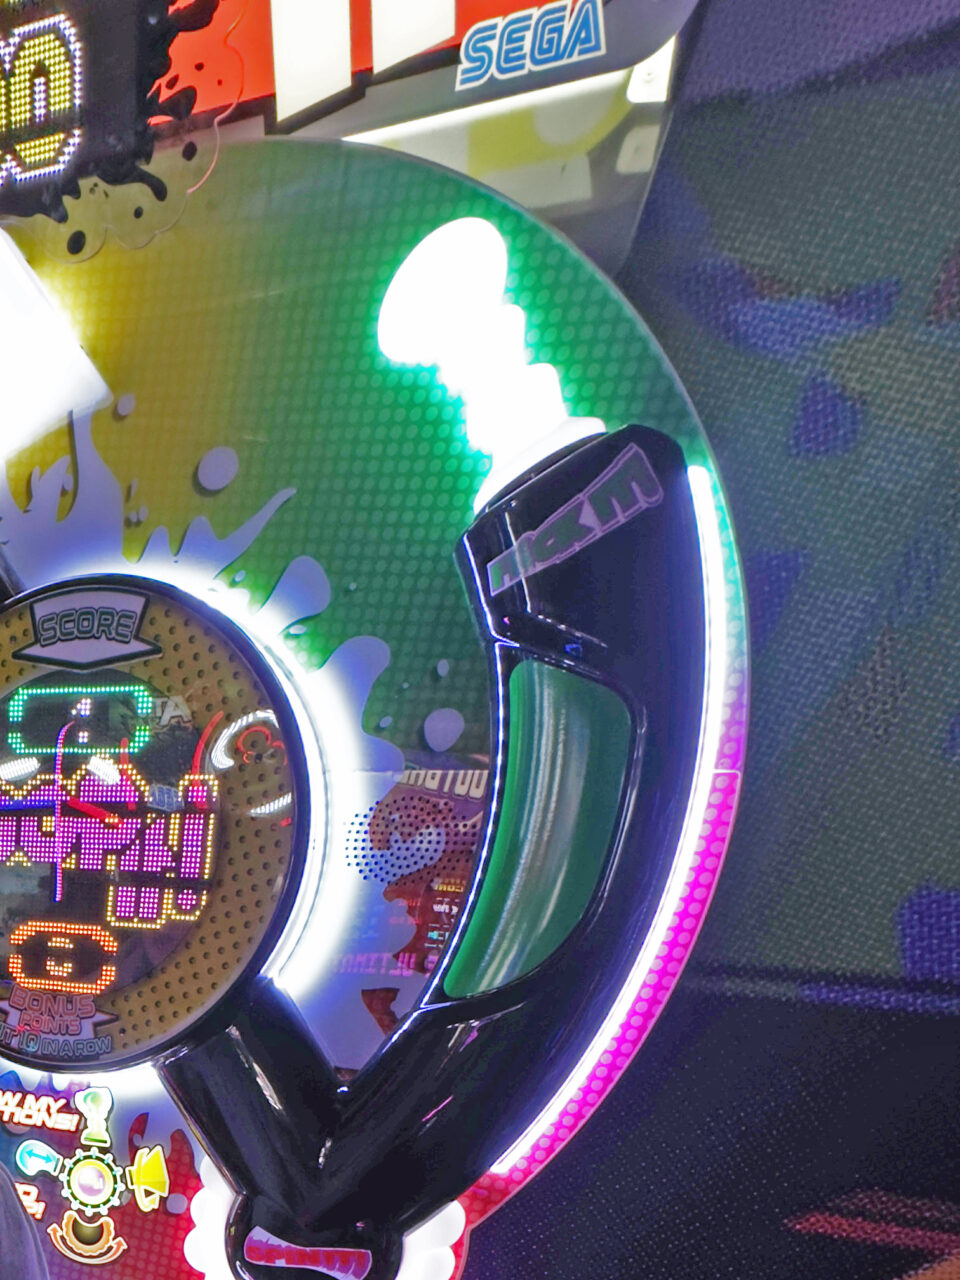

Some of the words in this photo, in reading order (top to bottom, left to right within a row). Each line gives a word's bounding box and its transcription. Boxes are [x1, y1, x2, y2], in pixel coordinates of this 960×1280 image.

[455, 0, 607, 91] SEGA
[38, 607, 138, 648] SCORE
[8, 984, 96, 1018] BONUS
[19, 1008, 82, 1036] POINTS
[41, 1037, 61, 1056] IN
[60, 1039, 74, 1056] A
[74, 1035, 112, 1056] ROW
[21, 1093, 68, 1114] MY
